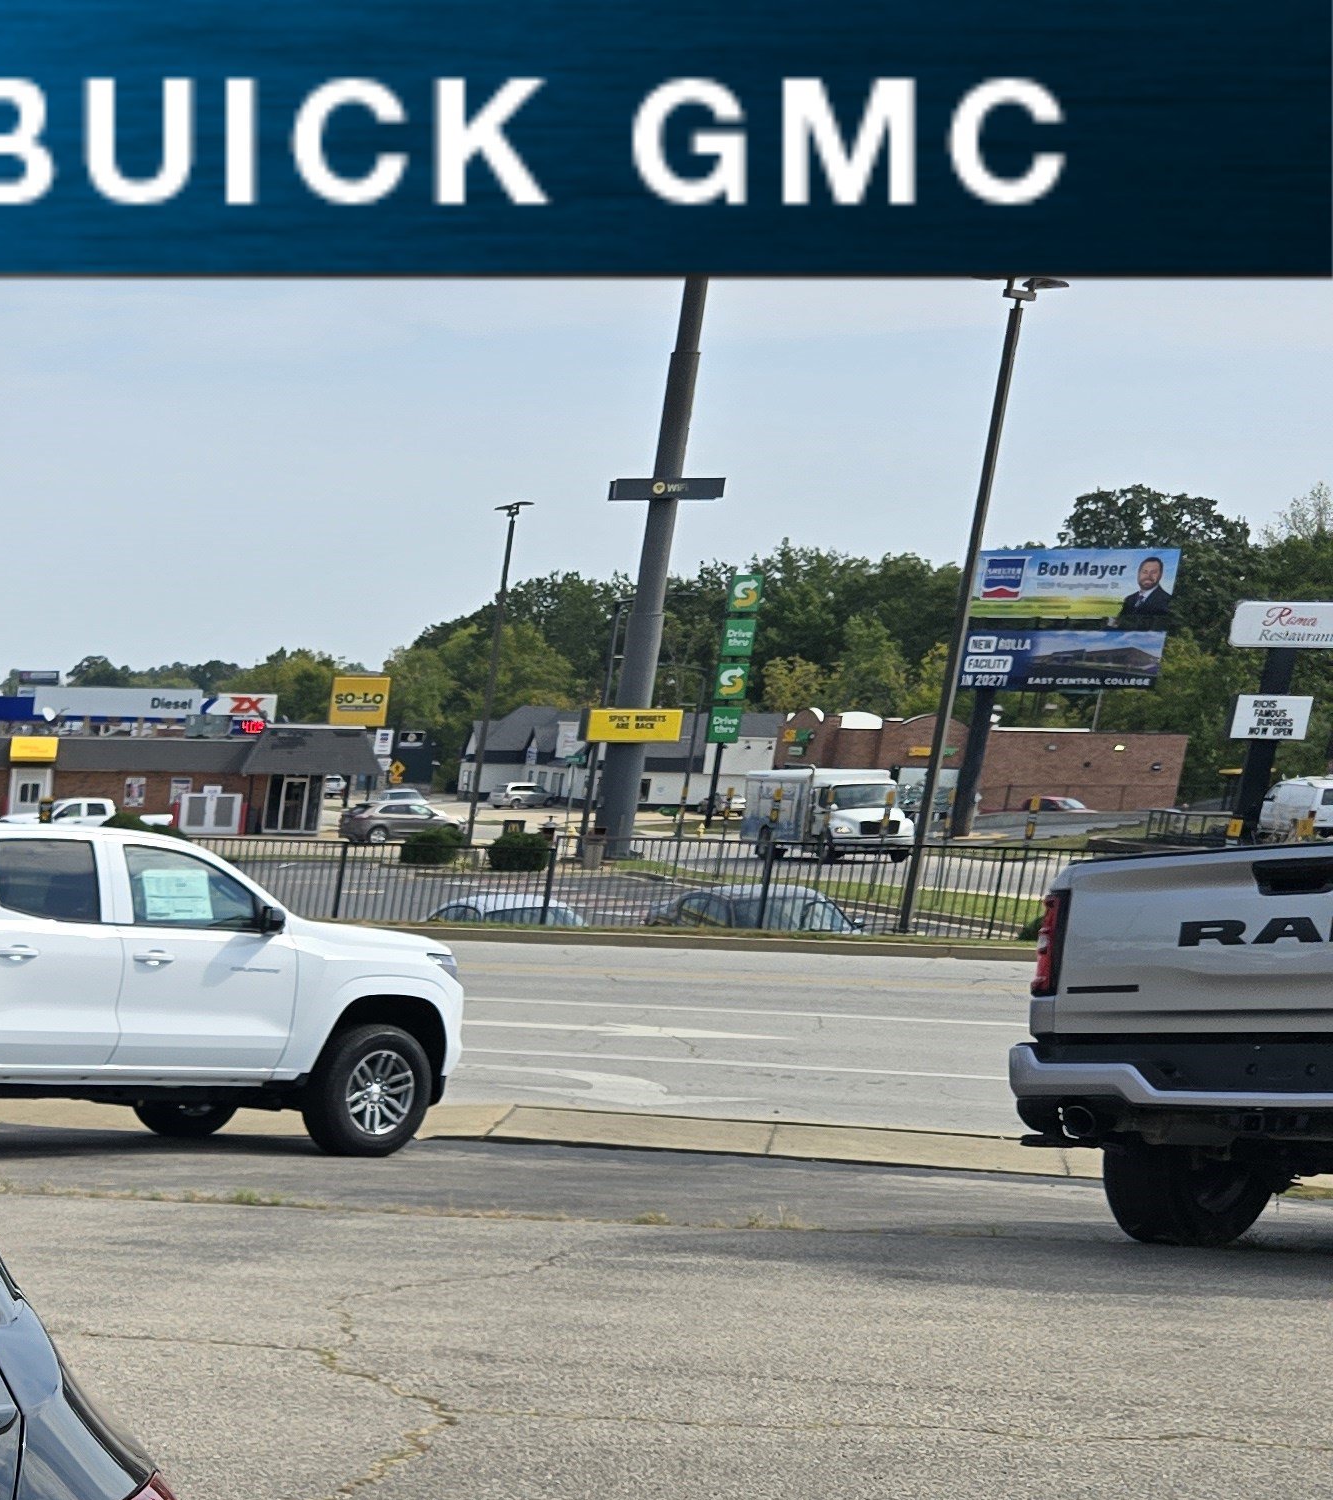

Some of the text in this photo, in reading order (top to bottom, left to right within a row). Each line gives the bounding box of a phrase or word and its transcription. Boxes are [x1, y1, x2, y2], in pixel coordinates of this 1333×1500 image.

[1037, 562, 1126, 578] Bob Mayer
[1027, 677, 1150, 686] EAST CENTRAL COLLEGE
[150, 697, 192, 710] Diesel
[334, 693, 383, 705] SO-LO
[1254, 709, 1287, 717] FAMOUS
[713, 716, 738, 726] Drive
[1256, 718, 1293, 727] BURGERS
[714, 725, 735, 734] thru
[1272, 727, 1293, 736] OPEN
[1178, 916, 1333, 947] RA
